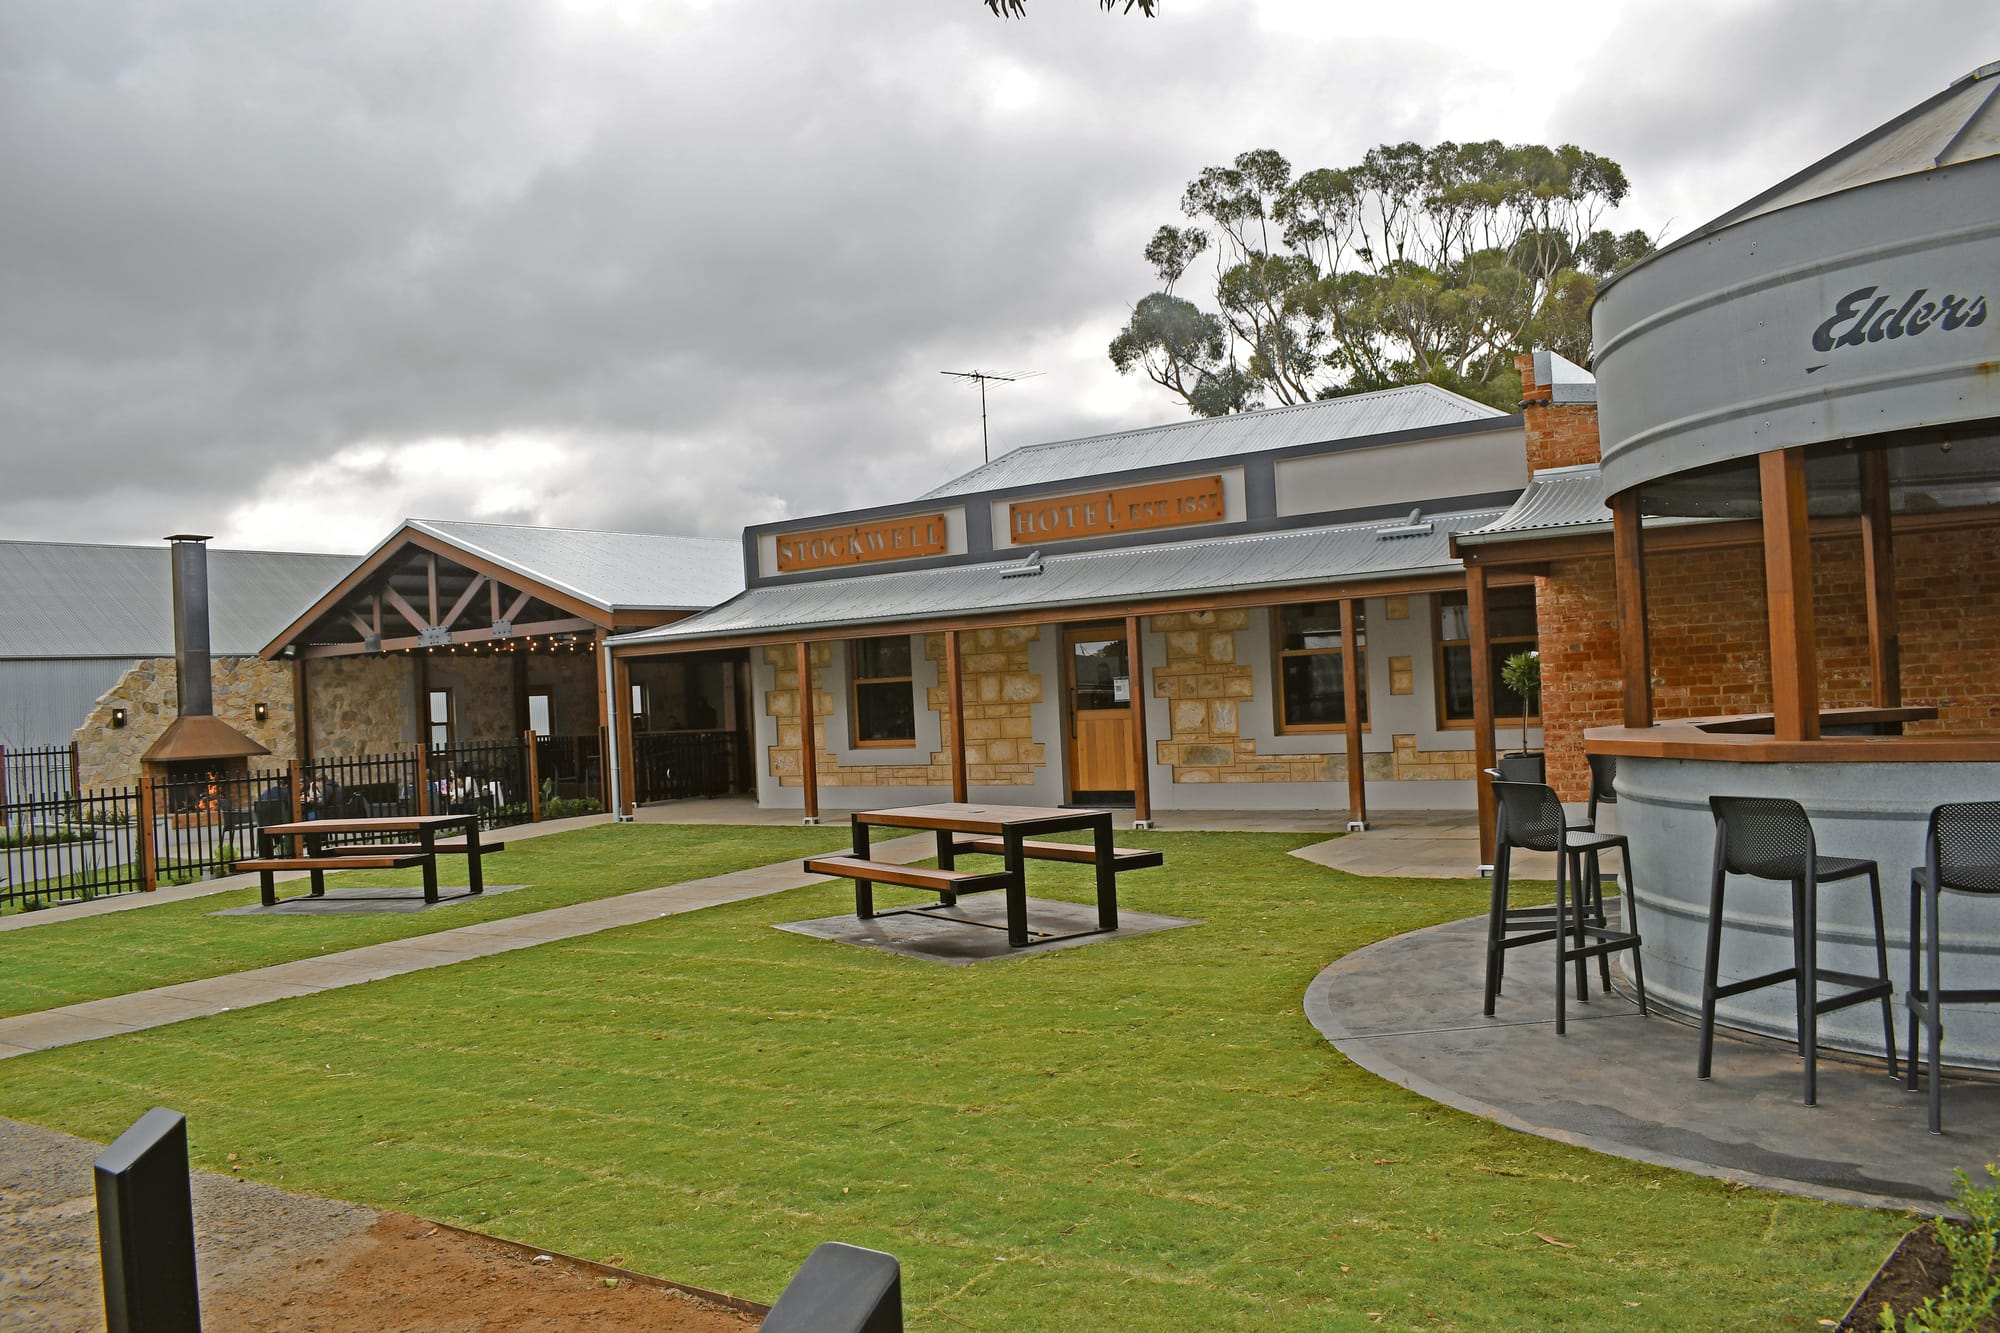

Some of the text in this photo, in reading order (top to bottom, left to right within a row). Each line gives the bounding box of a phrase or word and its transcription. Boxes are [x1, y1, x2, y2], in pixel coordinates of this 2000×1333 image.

[1812, 286, 1987, 352] Elders
[1014, 493, 1218, 535] HOTEL EST 1857
[780, 523, 941, 563] STOCKWELL
